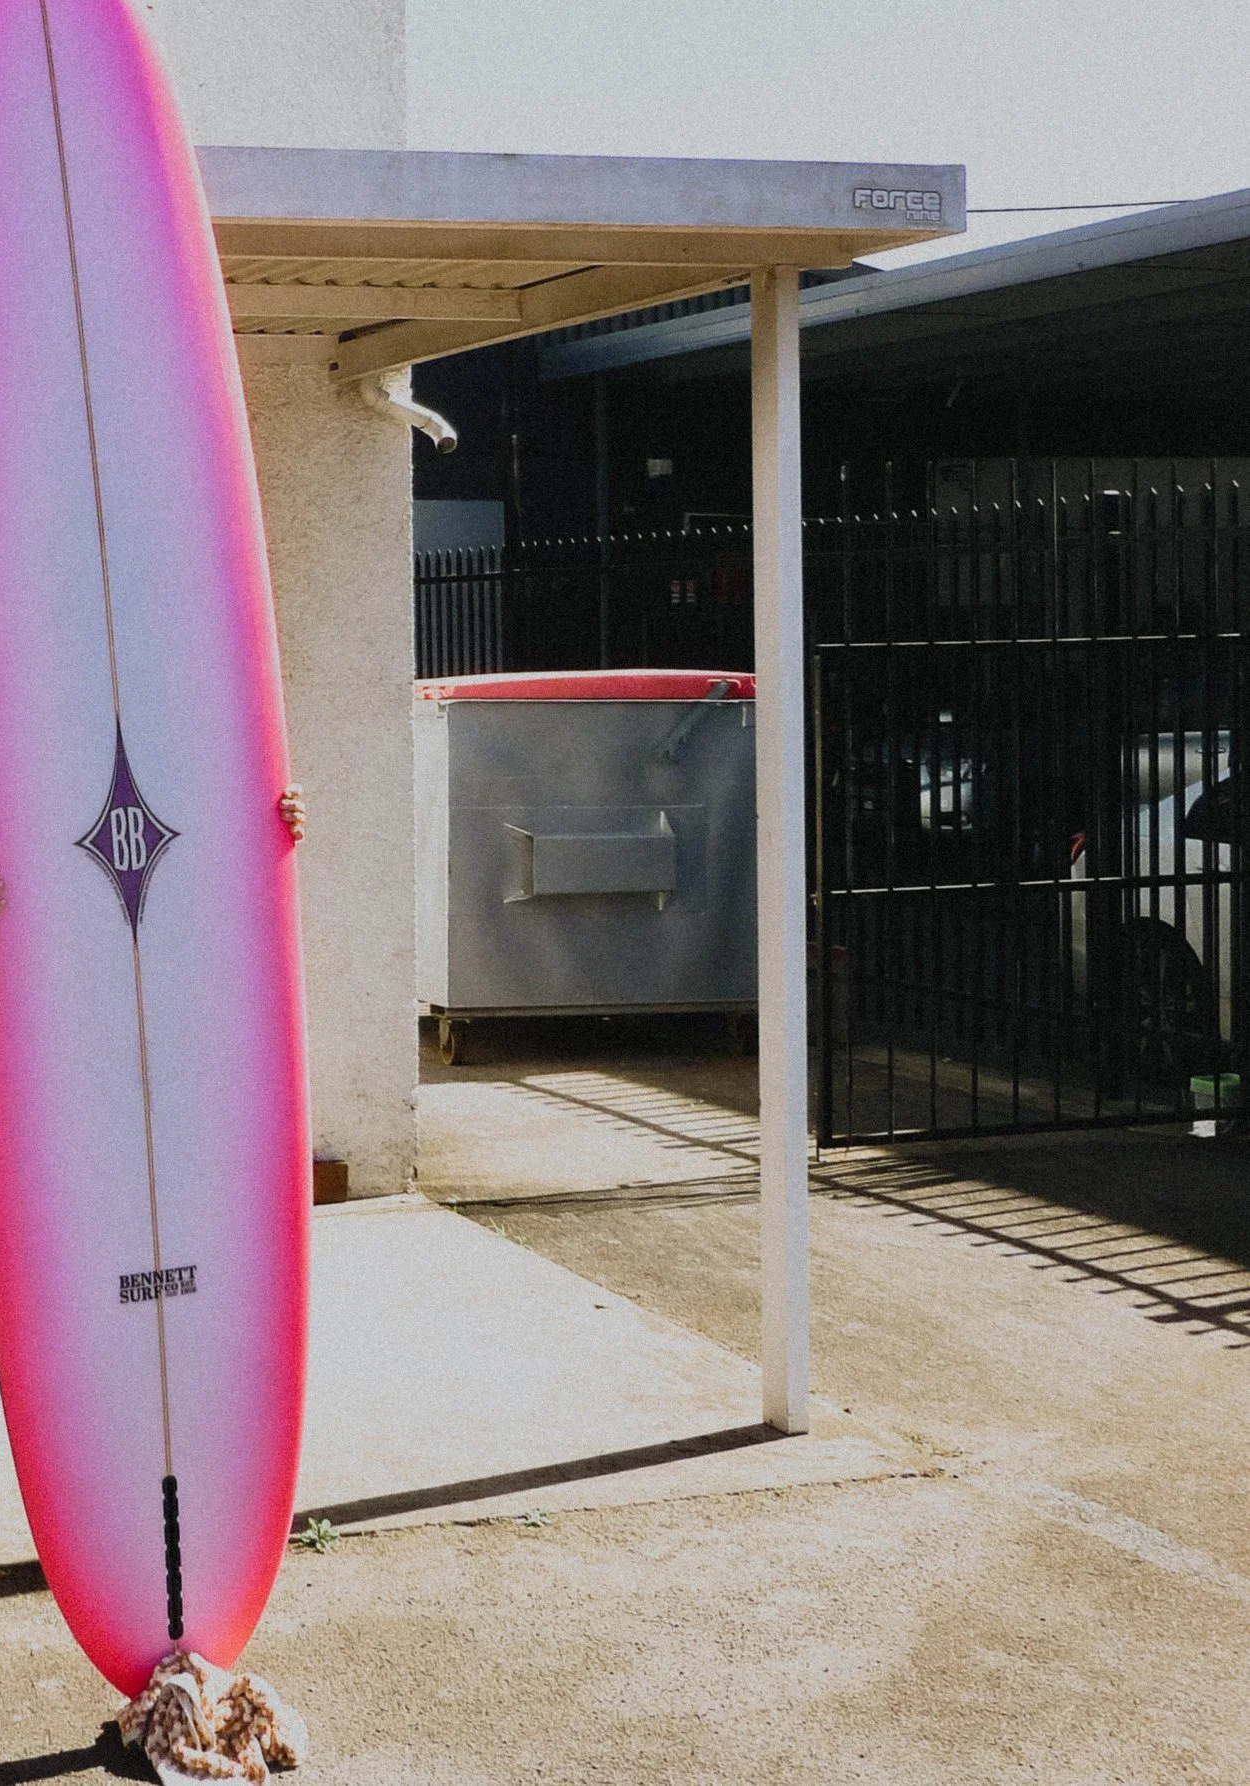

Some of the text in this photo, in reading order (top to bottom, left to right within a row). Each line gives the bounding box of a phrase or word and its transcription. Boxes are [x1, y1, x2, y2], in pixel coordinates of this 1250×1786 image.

[110, 806, 147, 871] BB
[119, 1265, 197, 1289] BENNETT
[119, 1285, 163, 1304] SURF
